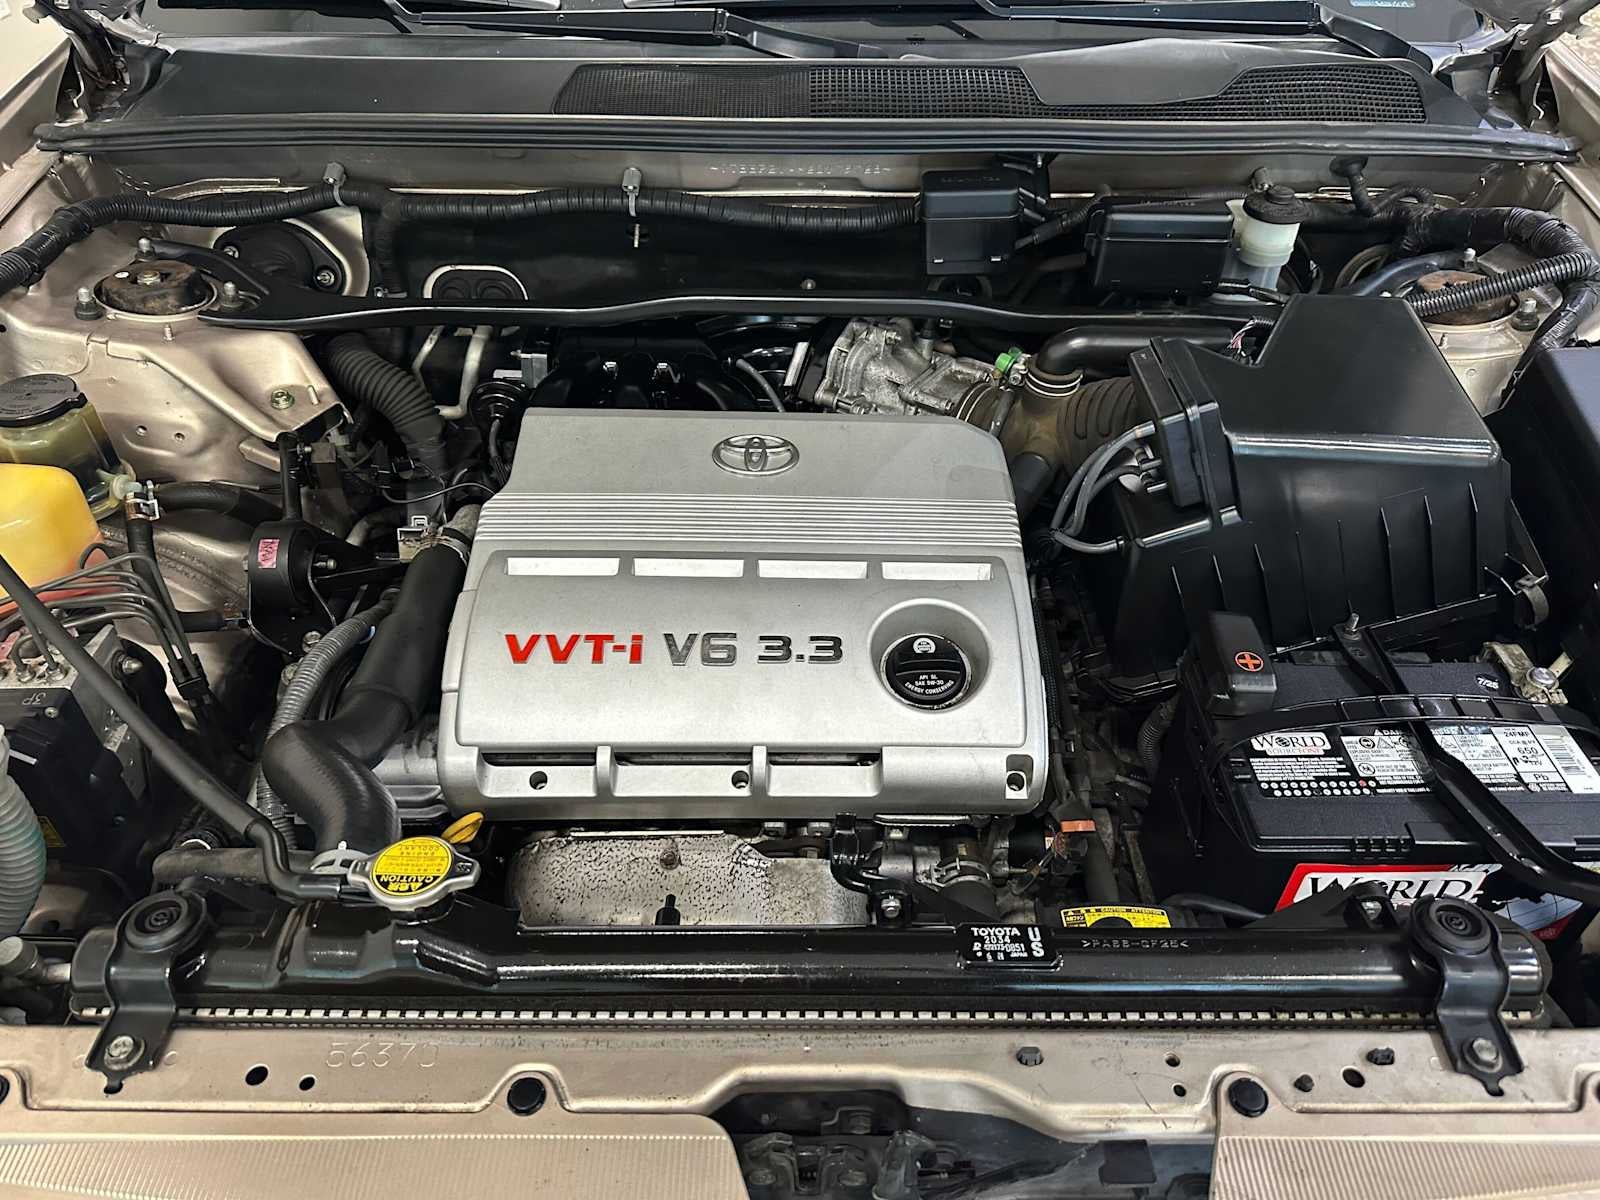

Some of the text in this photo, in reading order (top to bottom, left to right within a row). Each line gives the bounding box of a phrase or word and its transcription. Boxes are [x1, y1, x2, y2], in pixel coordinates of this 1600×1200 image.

[505, 632, 844, 667] VVT-i V6 3.3
[1254, 735, 1326, 748] WORLD
[1533, 773, 1550, 781] Pb
[380, 875, 434, 883] CAUTION
[971, 927, 1021, 937] TOYOTA
[984, 936, 1011, 944] 2034
